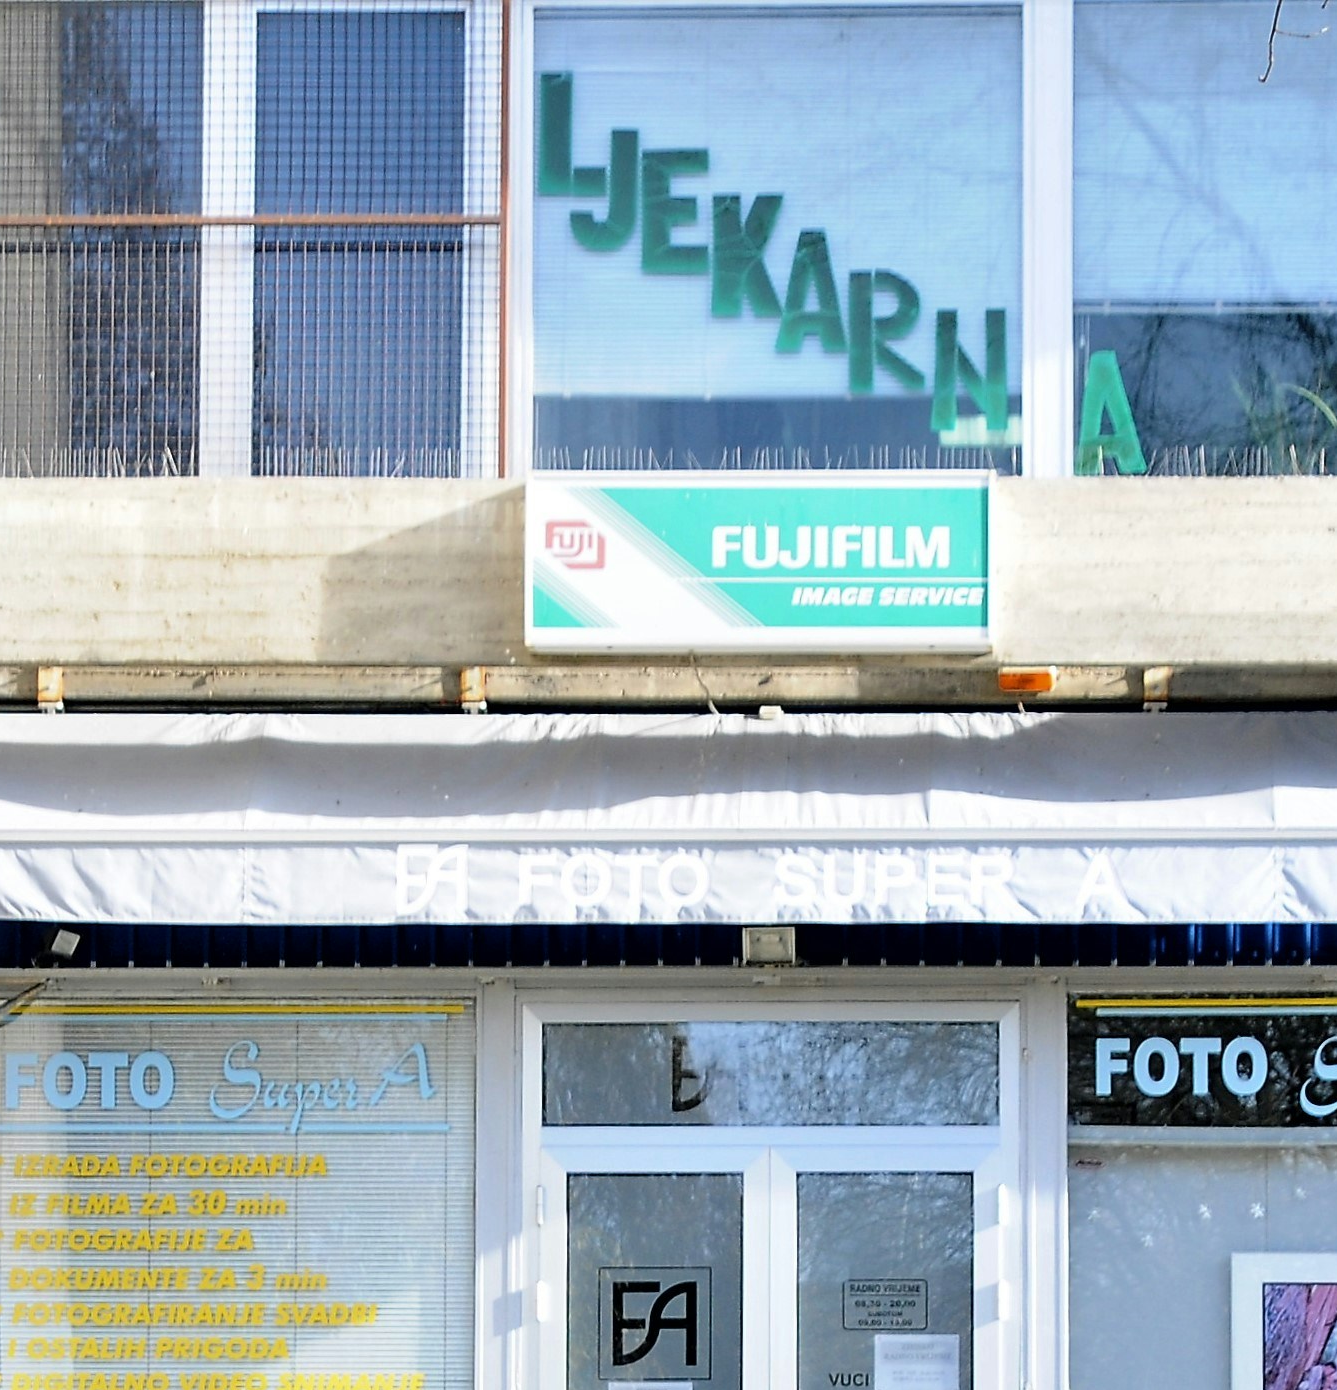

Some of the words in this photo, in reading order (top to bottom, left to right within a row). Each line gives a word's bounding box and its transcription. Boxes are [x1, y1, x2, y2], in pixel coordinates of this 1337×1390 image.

[539, 72, 1147, 475] LJEKARNA
[711, 524, 951, 569] FUJIFILM
[791, 586, 873, 607] IMAGE
[878, 586, 985, 607] SERVICE
[519, 853, 710, 908] FOTO
[773, 852, 1015, 905] SUPER
[1076, 852, 1129, 905] A
[1095, 1036, 1269, 1097] FOTO
[5, 1051, 175, 1110] FOTO
[208, 1040, 359, 1135] Super
[370, 1042, 436, 1107] A
[14, 1154, 120, 1177] IZRADA
[129, 1154, 327, 1177] FOTOGRAFIJA
[9, 1193, 36, 1216] IZ
[45, 1193, 131, 1216] FILMA
[139, 1193, 178, 1216] ZA
[187, 1190, 227, 1216] 30
[234, 1192, 287, 1216] min
[14, 1229, 205, 1251] FOTOGRAFIJE
[217, 1229, 255, 1251] ZA
[8, 1267, 188, 1290] DOKUMENTE
[197, 1267, 237, 1290] ZA
[245, 1264, 264, 1290] 3
[275, 1267, 329, 1290] min
[11, 1303, 264, 1326] FOTOGRAFIRANJE
[274, 1303, 379, 1326] SVADBI
[7, 1337, 17, 1359] I
[27, 1337, 145, 1359] OSTALIH
[155, 1337, 290, 1359] PRIGODA
[828, 1373, 870, 1387] VUCI
